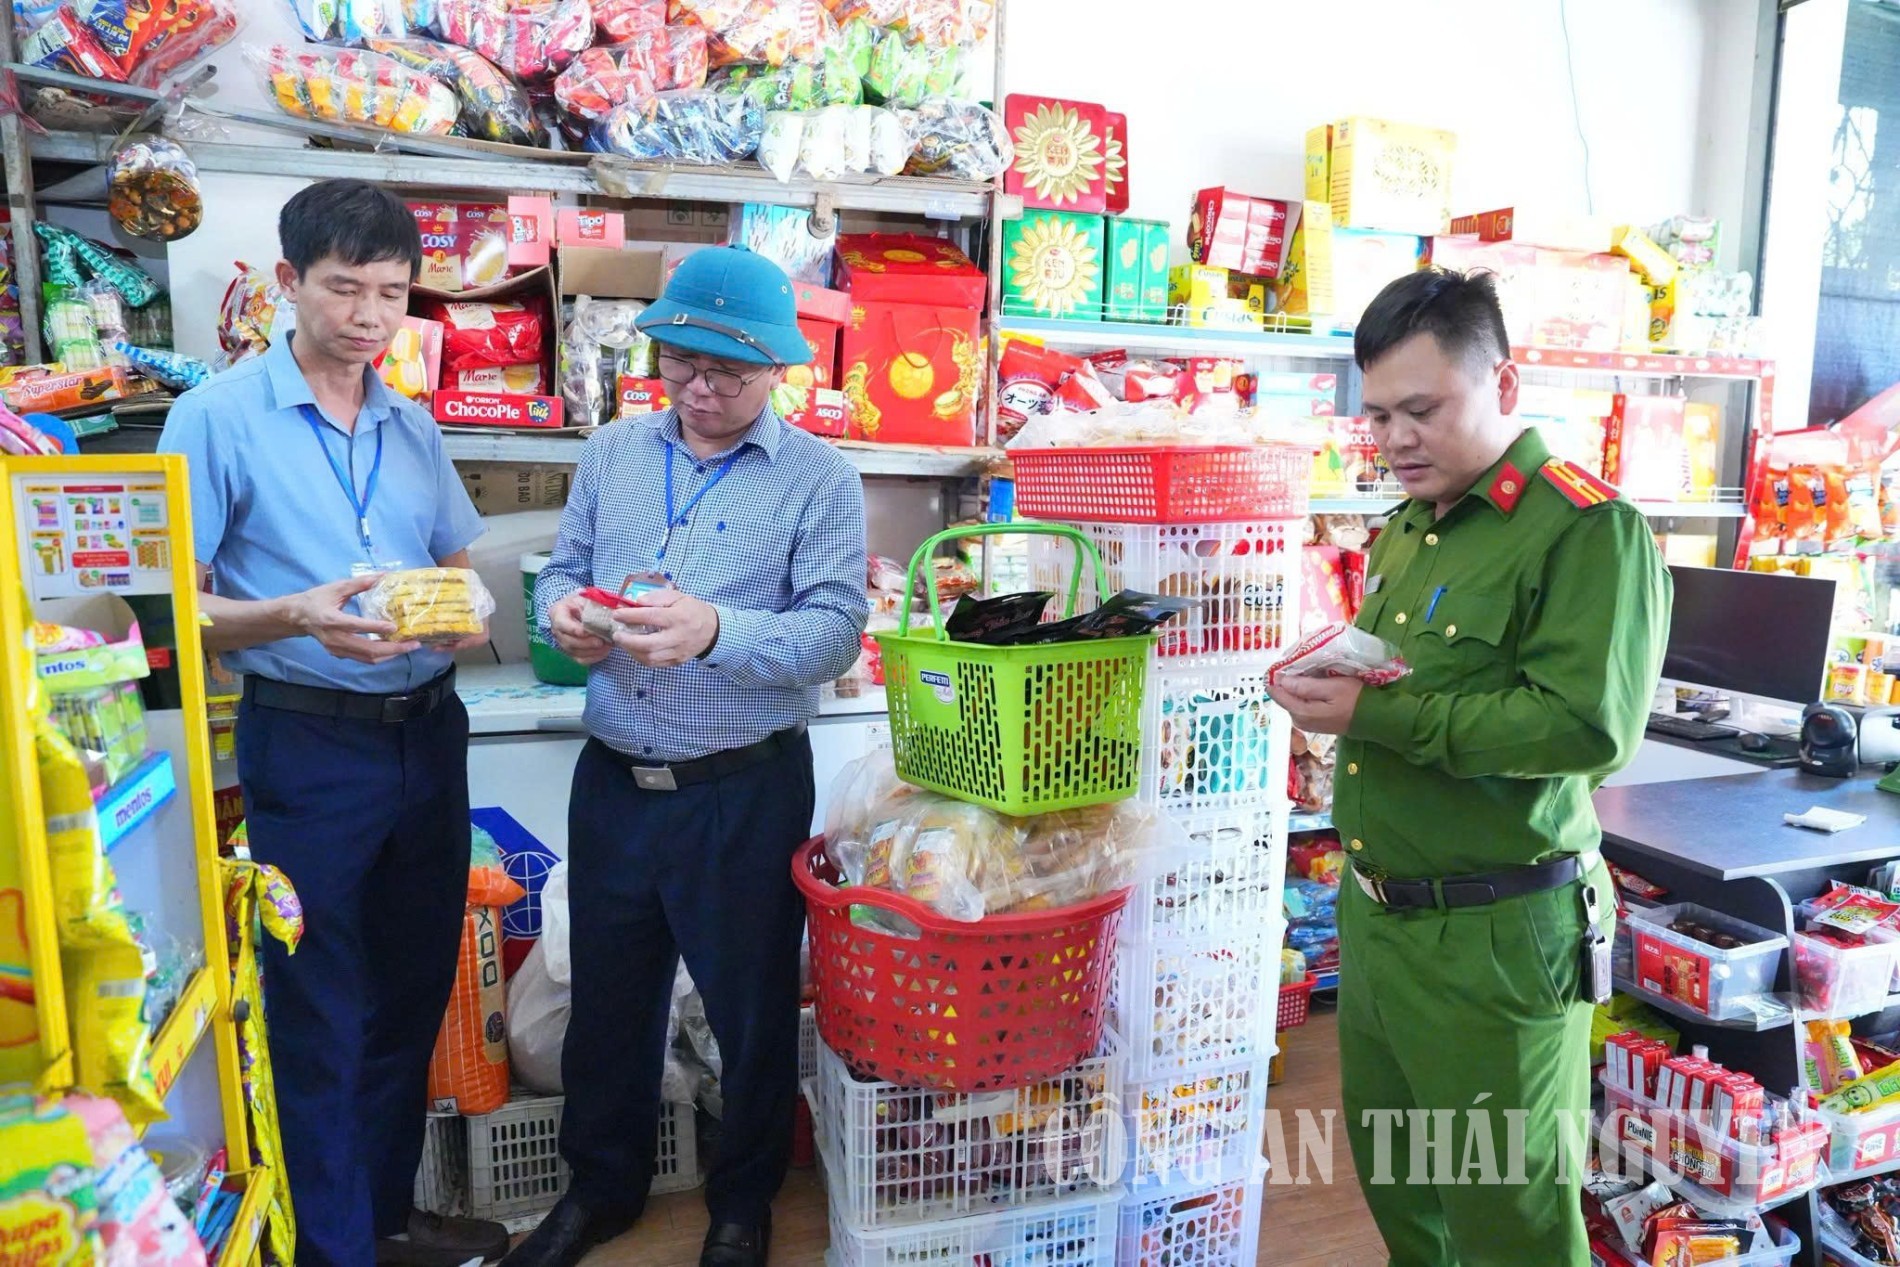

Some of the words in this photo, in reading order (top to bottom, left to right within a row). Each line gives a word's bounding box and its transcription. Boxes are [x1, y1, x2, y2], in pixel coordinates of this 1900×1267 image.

[413, 209, 434, 218] COSY
[465, 209, 486, 219] COSY
[422, 234, 458, 249] COSY
[428, 262, 454, 275] Marie
[463, 370, 498, 383] Marie
[23, 376, 83, 399] Superstar
[473, 395, 501, 404] ORION
[623, 390, 652, 401] COSY
[445, 400, 520, 420] ChocoPie
[815, 408, 843, 420] COSY
[114, 787, 153, 829] mentos
